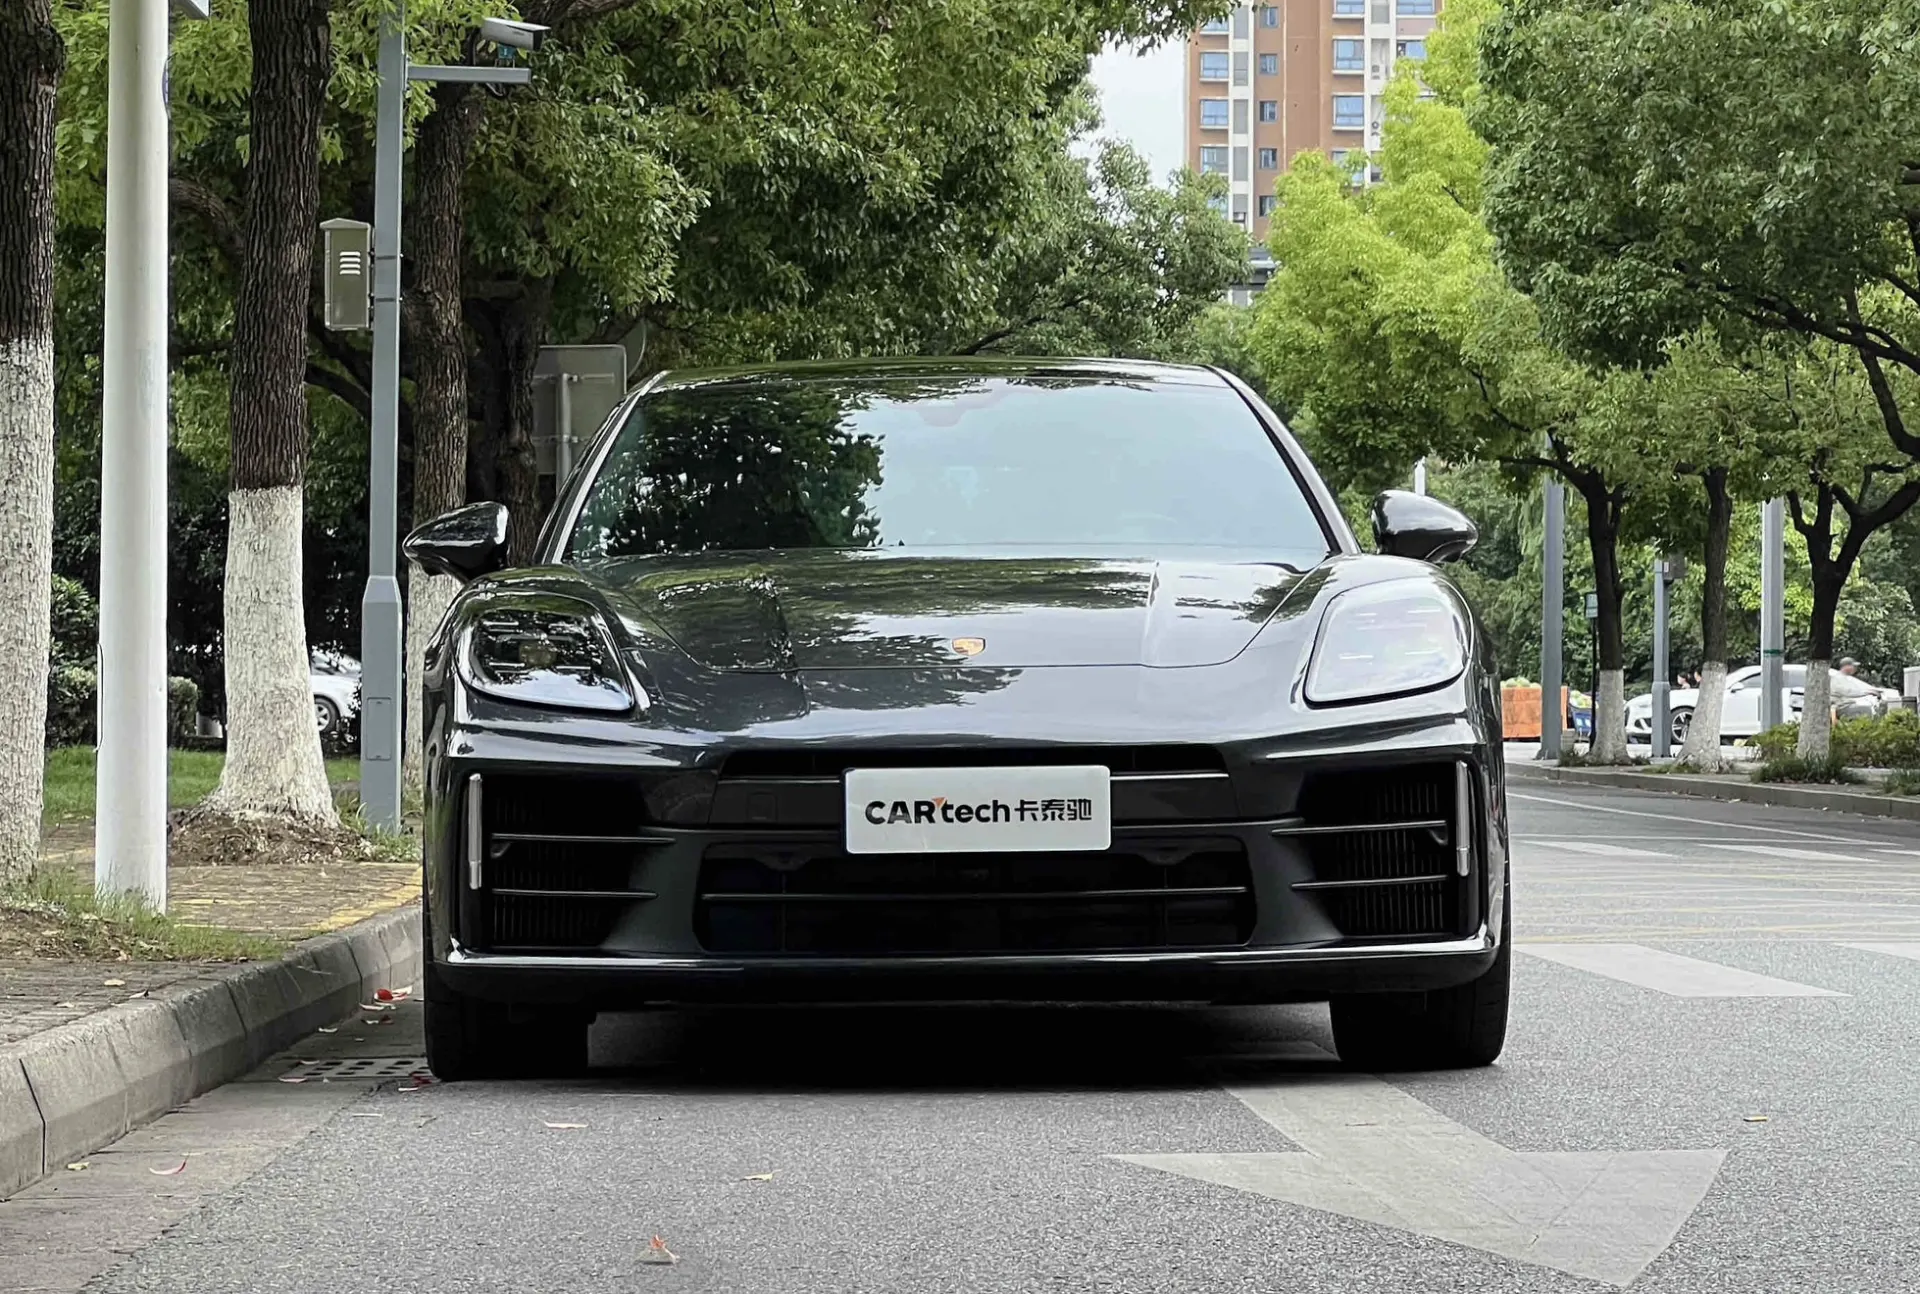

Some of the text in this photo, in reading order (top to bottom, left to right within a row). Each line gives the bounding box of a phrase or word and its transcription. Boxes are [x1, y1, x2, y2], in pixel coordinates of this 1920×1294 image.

[865, 797, 1092, 825] CARtech 卡泰驰
